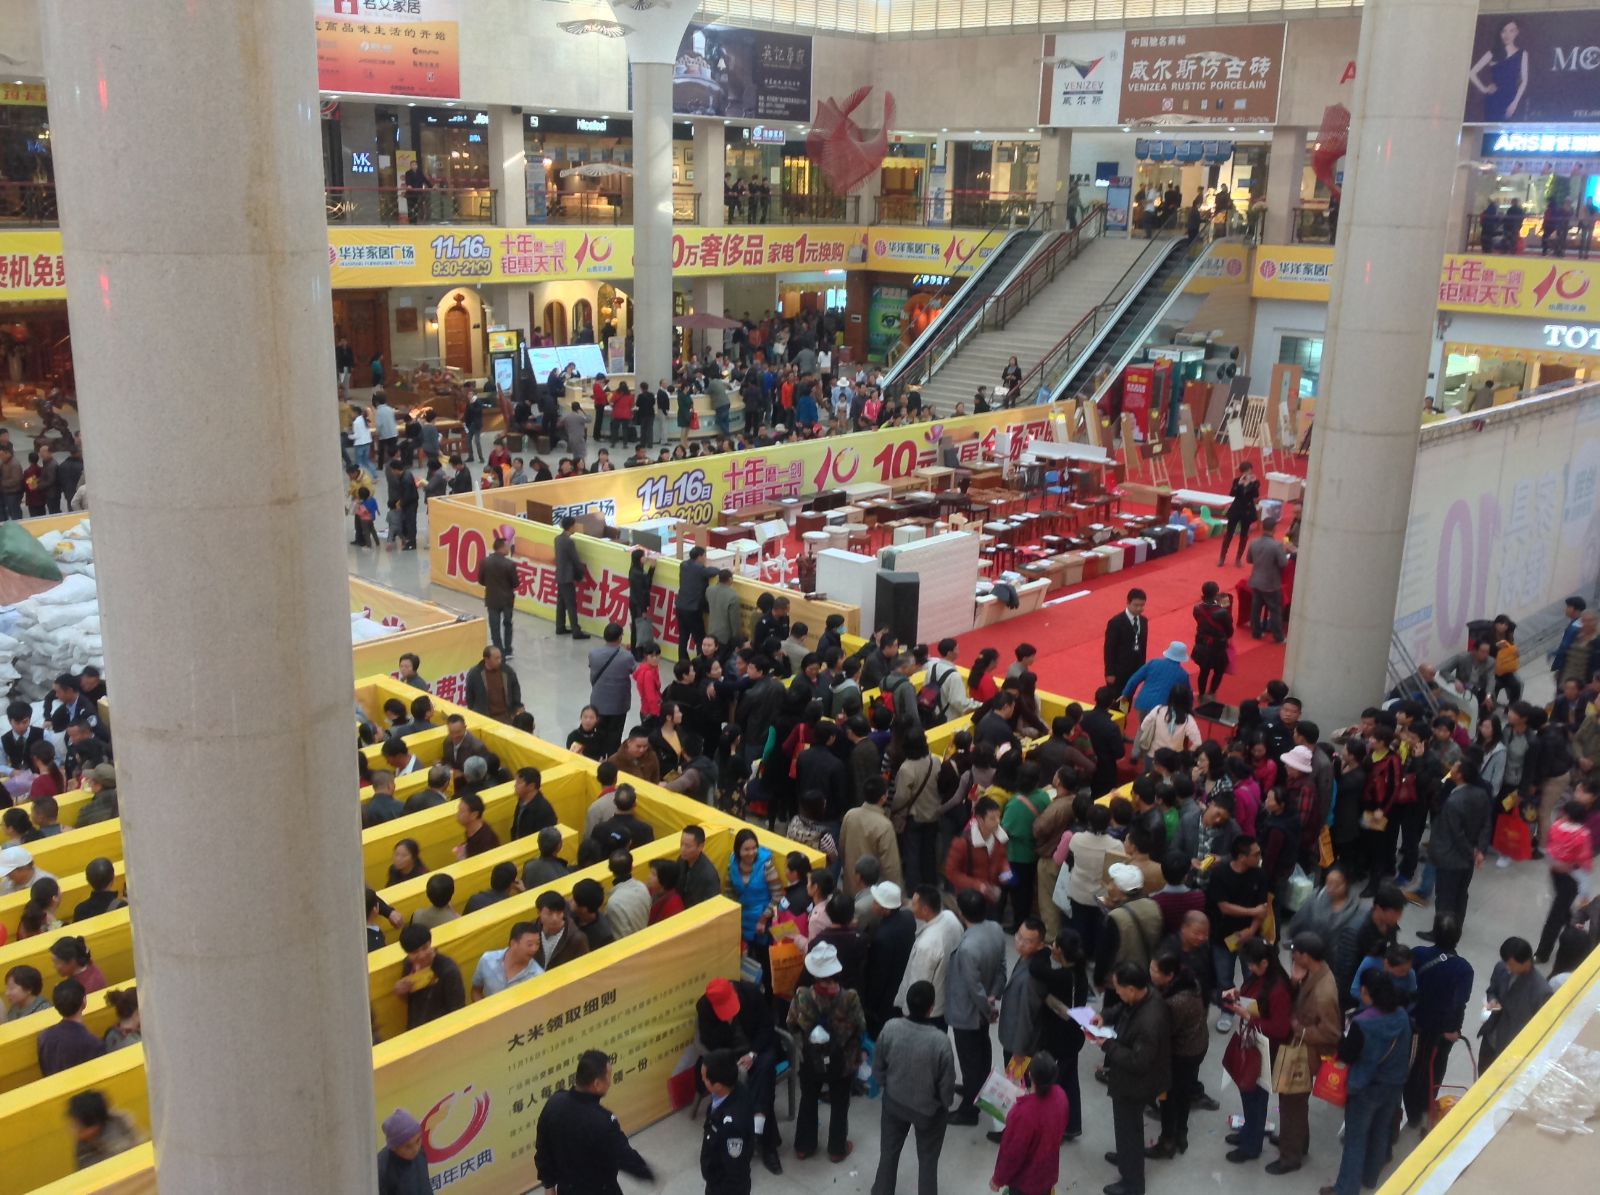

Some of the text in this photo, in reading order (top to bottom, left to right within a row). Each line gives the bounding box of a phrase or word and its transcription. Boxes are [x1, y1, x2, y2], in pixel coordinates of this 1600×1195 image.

[1129, 56, 1272, 81] 威尔斯仿古砖
[1128, 79, 1267, 92] VENIZEA RUSTIC PORCELAIN
[352, 152, 371, 166] MK
[339, 245, 415, 260] 华洋家居广场
[767, 233, 845, 264] 家电1元换购
[501, 255, 566, 274] 钜惠天下
[637, 469, 712, 512] 11月16日
[508, 987, 617, 1052] 大米领取细则
